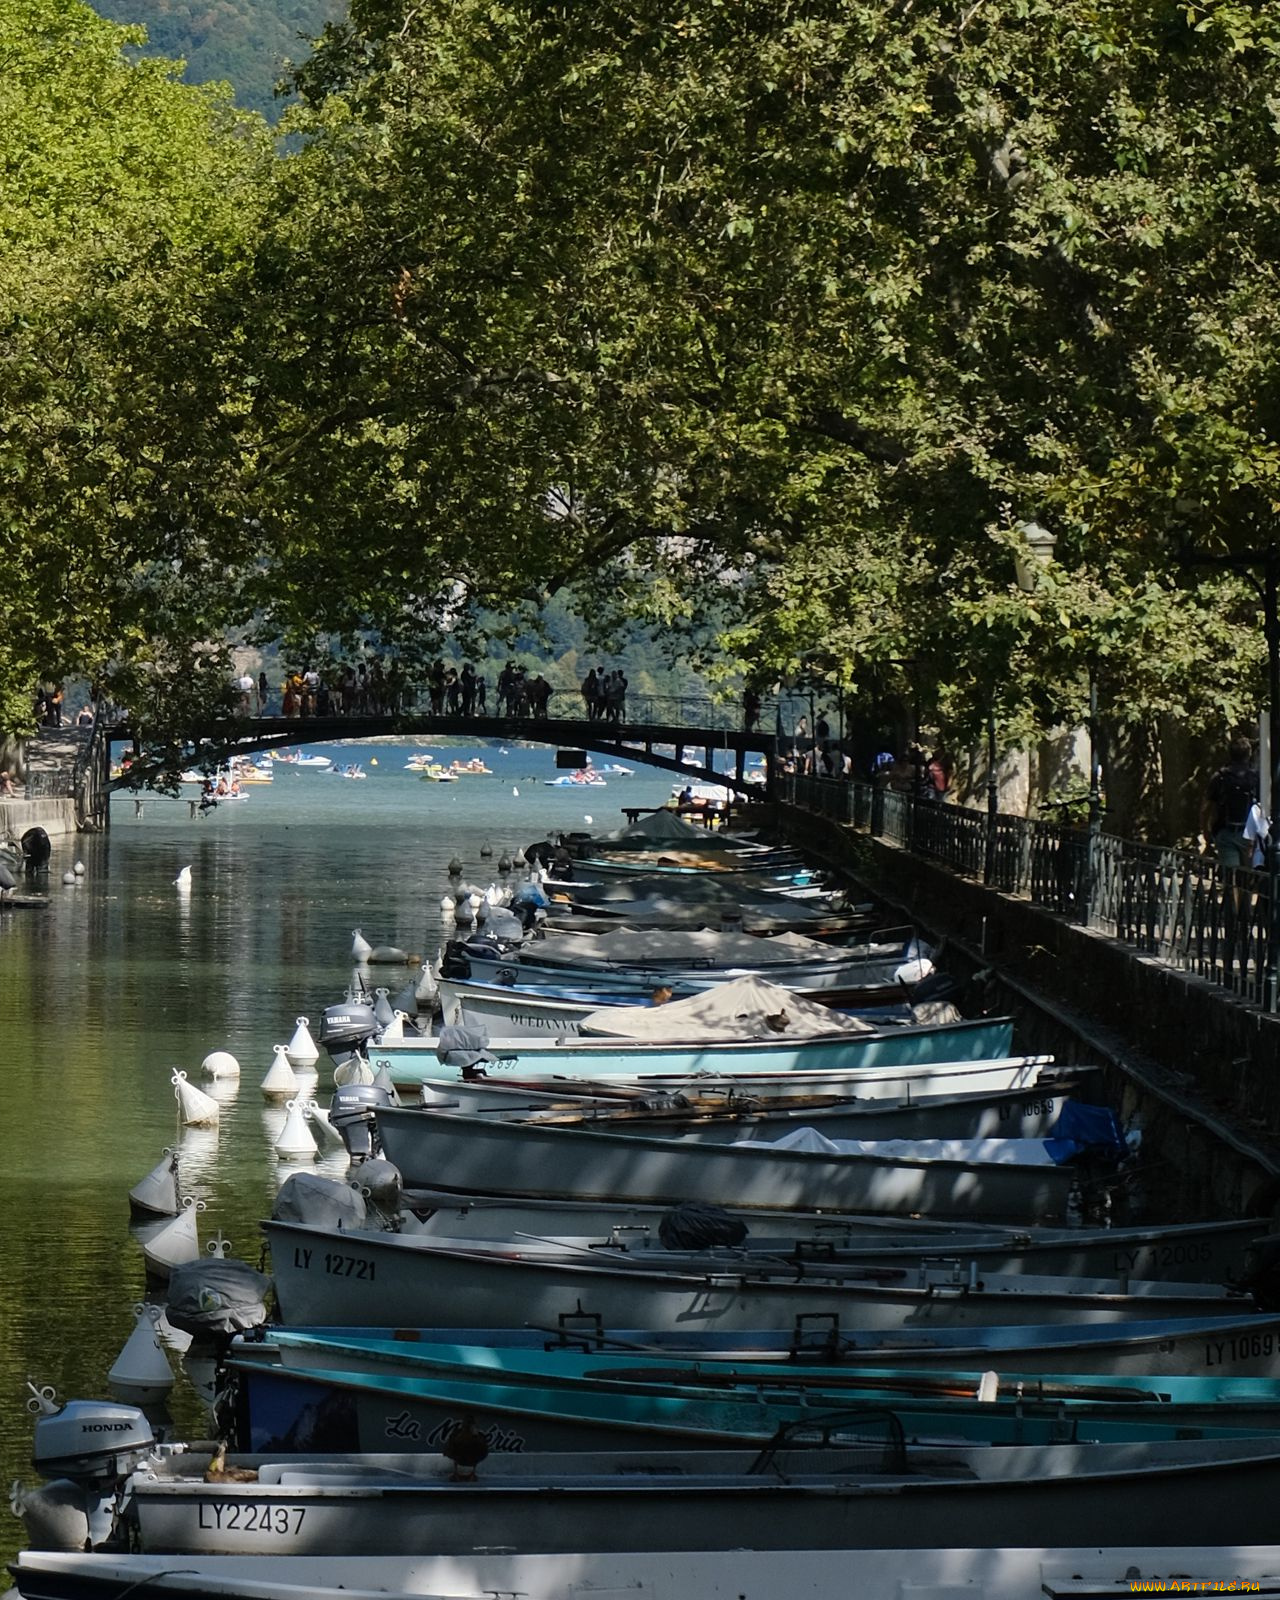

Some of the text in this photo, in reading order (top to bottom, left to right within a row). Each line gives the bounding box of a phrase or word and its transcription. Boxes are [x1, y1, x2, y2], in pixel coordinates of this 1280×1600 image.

[326, 1016, 351, 1024] YAMAHA
[294, 1247, 376, 1281] LY 12721
[1114, 1242, 1211, 1271] LY 12005
[1231, 1333, 1280, 1361] 1069
[81, 1423, 134, 1432] HONDA
[385, 1410, 421, 1440] La
[198, 1502, 306, 1535] LY22437
